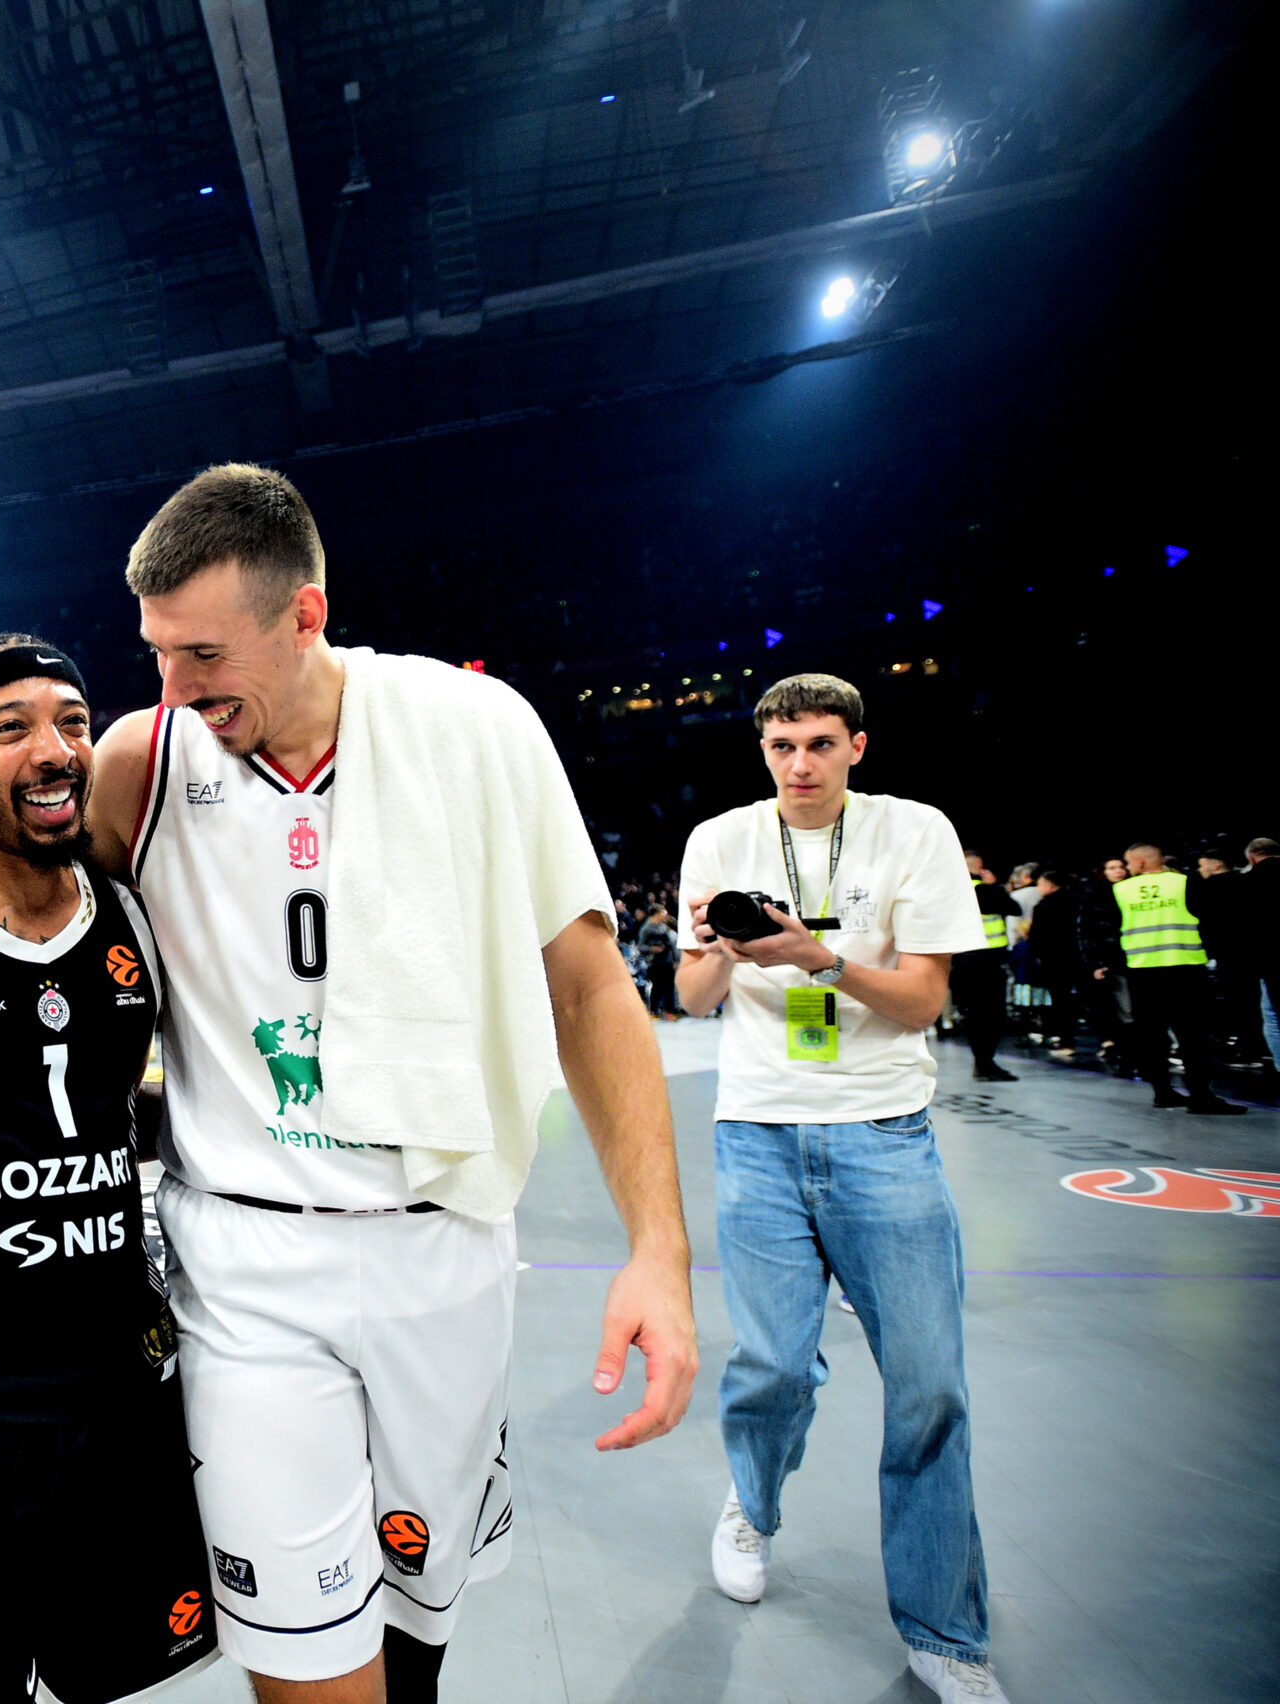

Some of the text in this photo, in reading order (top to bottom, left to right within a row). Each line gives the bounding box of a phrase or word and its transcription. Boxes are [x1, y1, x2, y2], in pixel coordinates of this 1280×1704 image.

[186, 780, 223, 799] EA7
[288, 830, 319, 861] 90
[1140, 885, 1160, 899] 52
[284, 888, 329, 982] 0
[43, 1044, 78, 1139] 1
[63, 1211, 125, 1258] NIS
[215, 1550, 248, 1579] EA7
[318, 1556, 352, 1589] EA7
